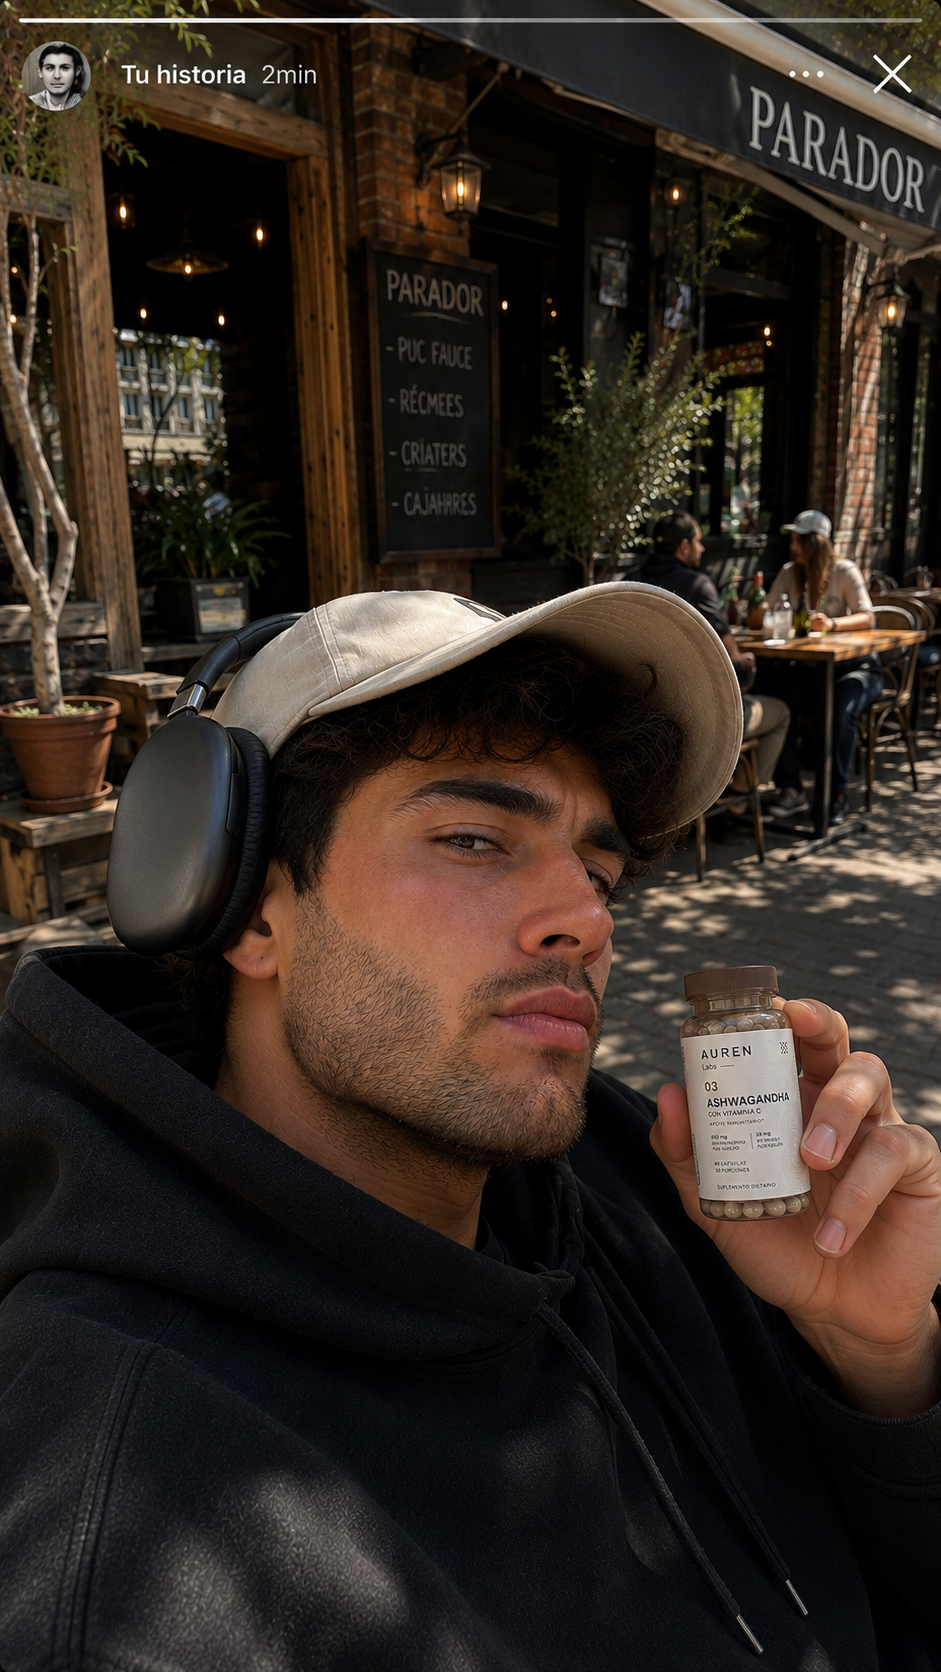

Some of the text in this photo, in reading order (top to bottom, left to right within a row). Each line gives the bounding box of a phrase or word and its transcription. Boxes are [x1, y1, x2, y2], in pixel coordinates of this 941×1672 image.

[749, 86, 925, 214] PARADOR
[386, 268, 485, 317] PARADOR
[431, 341, 473, 371] FAUCE
[701, 1045, 752, 1059] AUREN
[702, 1063, 717, 1071] Labs
[704, 1081, 718, 1091] 03
[707, 1092, 790, 1108] ASHWAGANDHA
